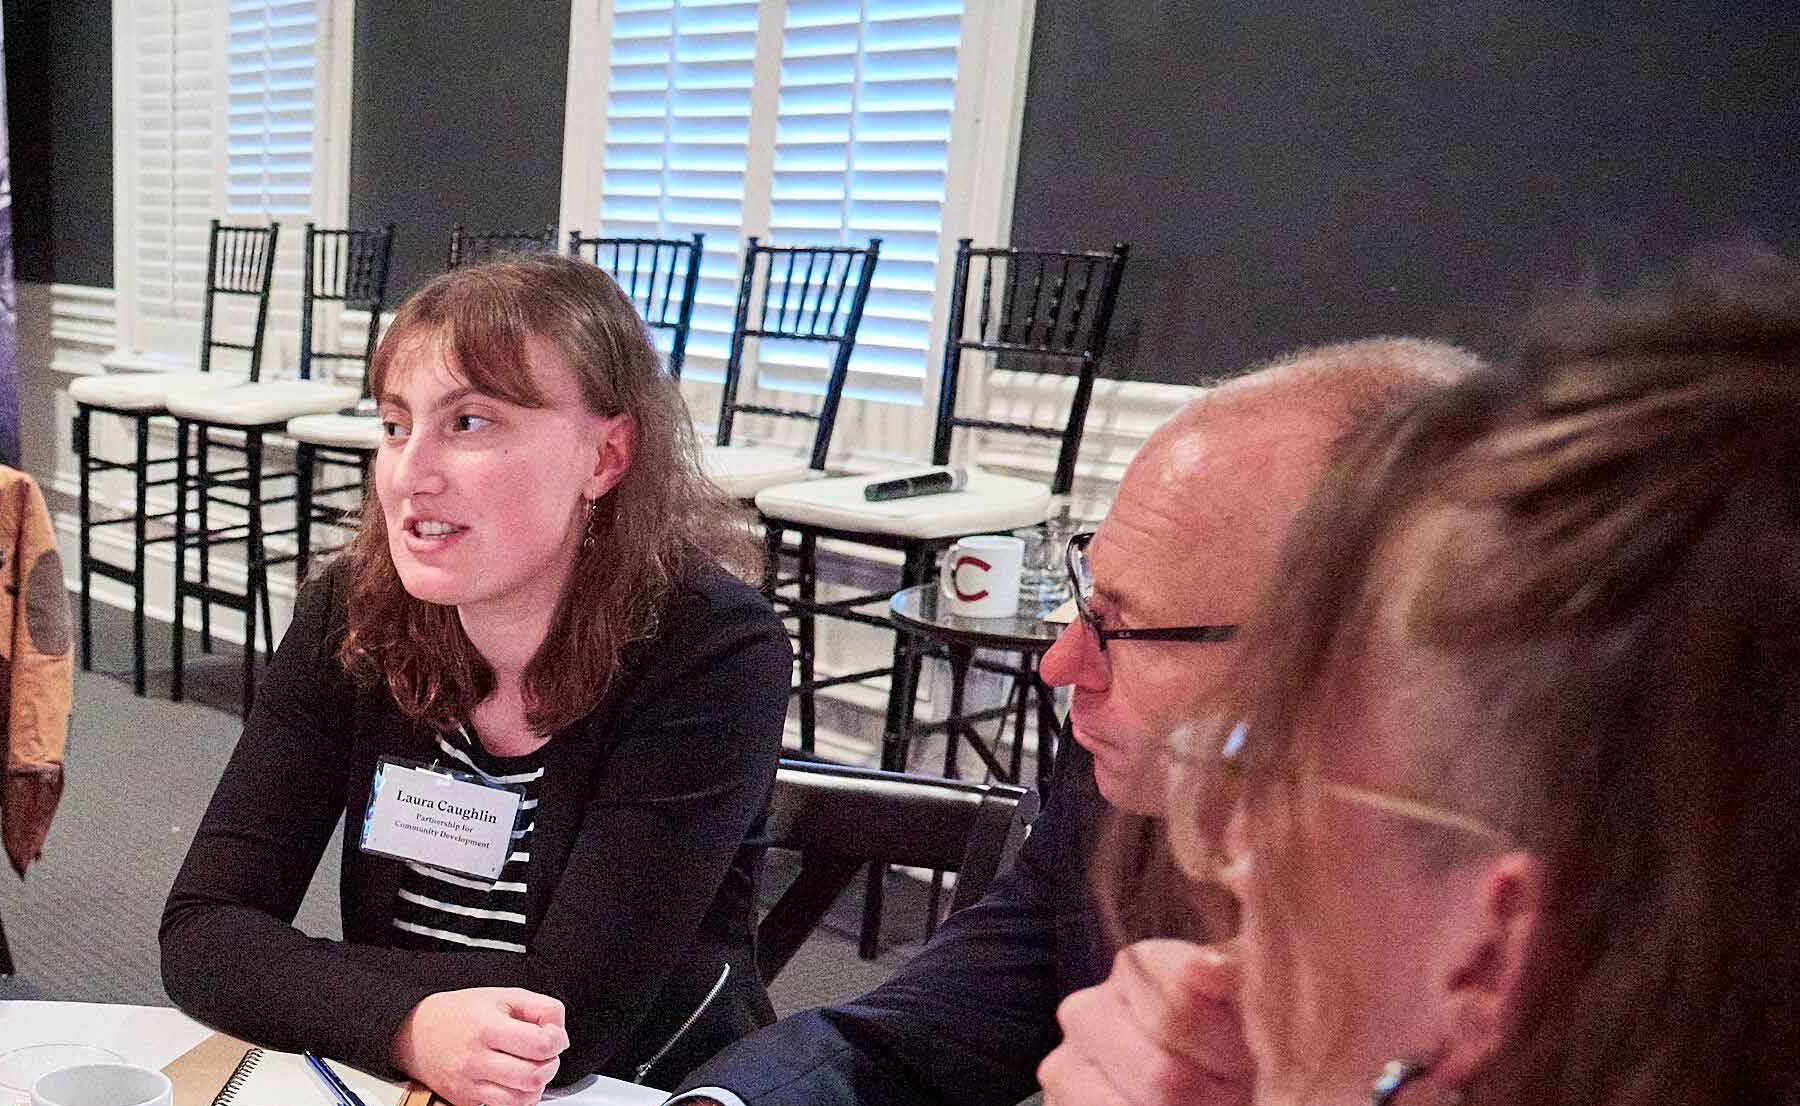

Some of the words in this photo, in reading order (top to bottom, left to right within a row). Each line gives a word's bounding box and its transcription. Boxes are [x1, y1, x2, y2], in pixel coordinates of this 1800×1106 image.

[953, 555, 993, 602] C
[397, 790, 434, 808] Laura
[437, 800, 497, 824] Caughlin
[394, 820, 439, 837] Community
[439, 830, 490, 849] Development
[416, 813, 461, 830] Partnership
[461, 824, 473, 833] for
